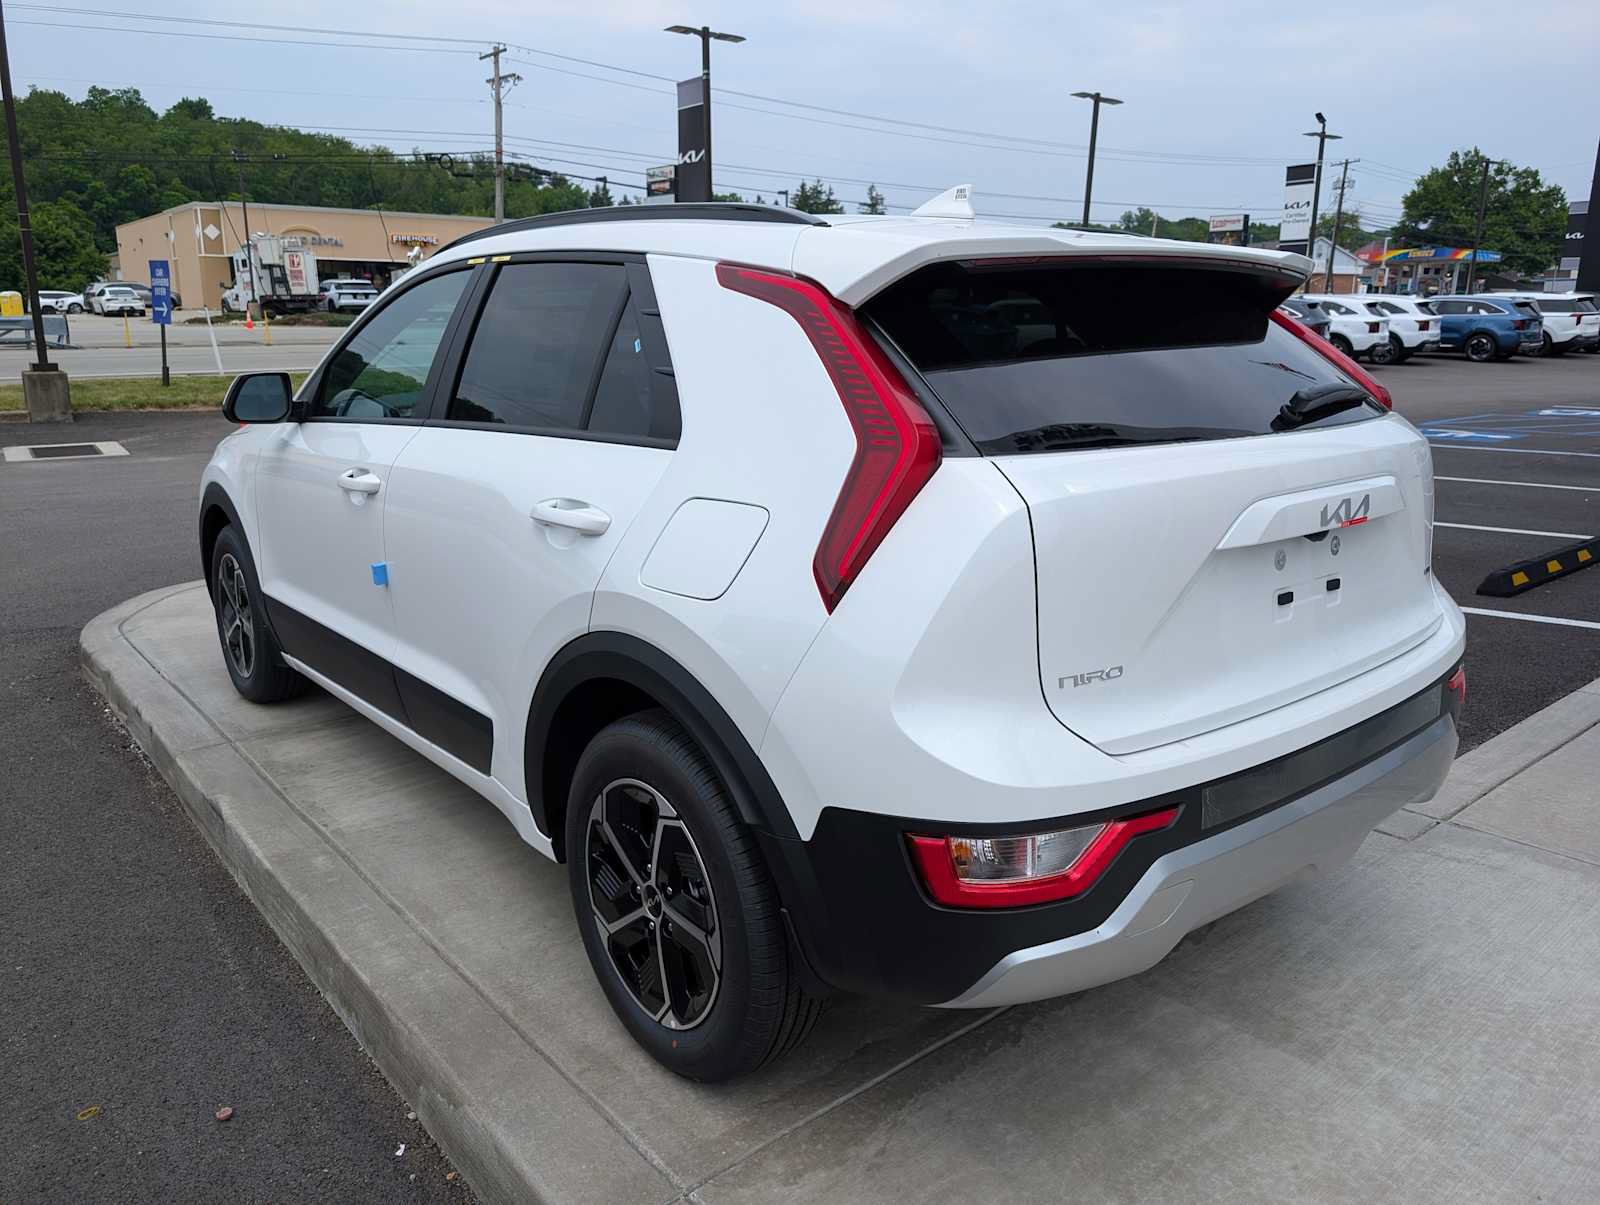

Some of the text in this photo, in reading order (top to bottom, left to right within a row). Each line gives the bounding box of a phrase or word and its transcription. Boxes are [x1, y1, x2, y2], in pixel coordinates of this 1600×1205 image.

[1285, 200, 1311, 210] KIA
[391, 234, 438, 245] FIREHOUSE
[1321, 494, 1369, 527] KIA
[1059, 665, 1123, 688] NIRO
